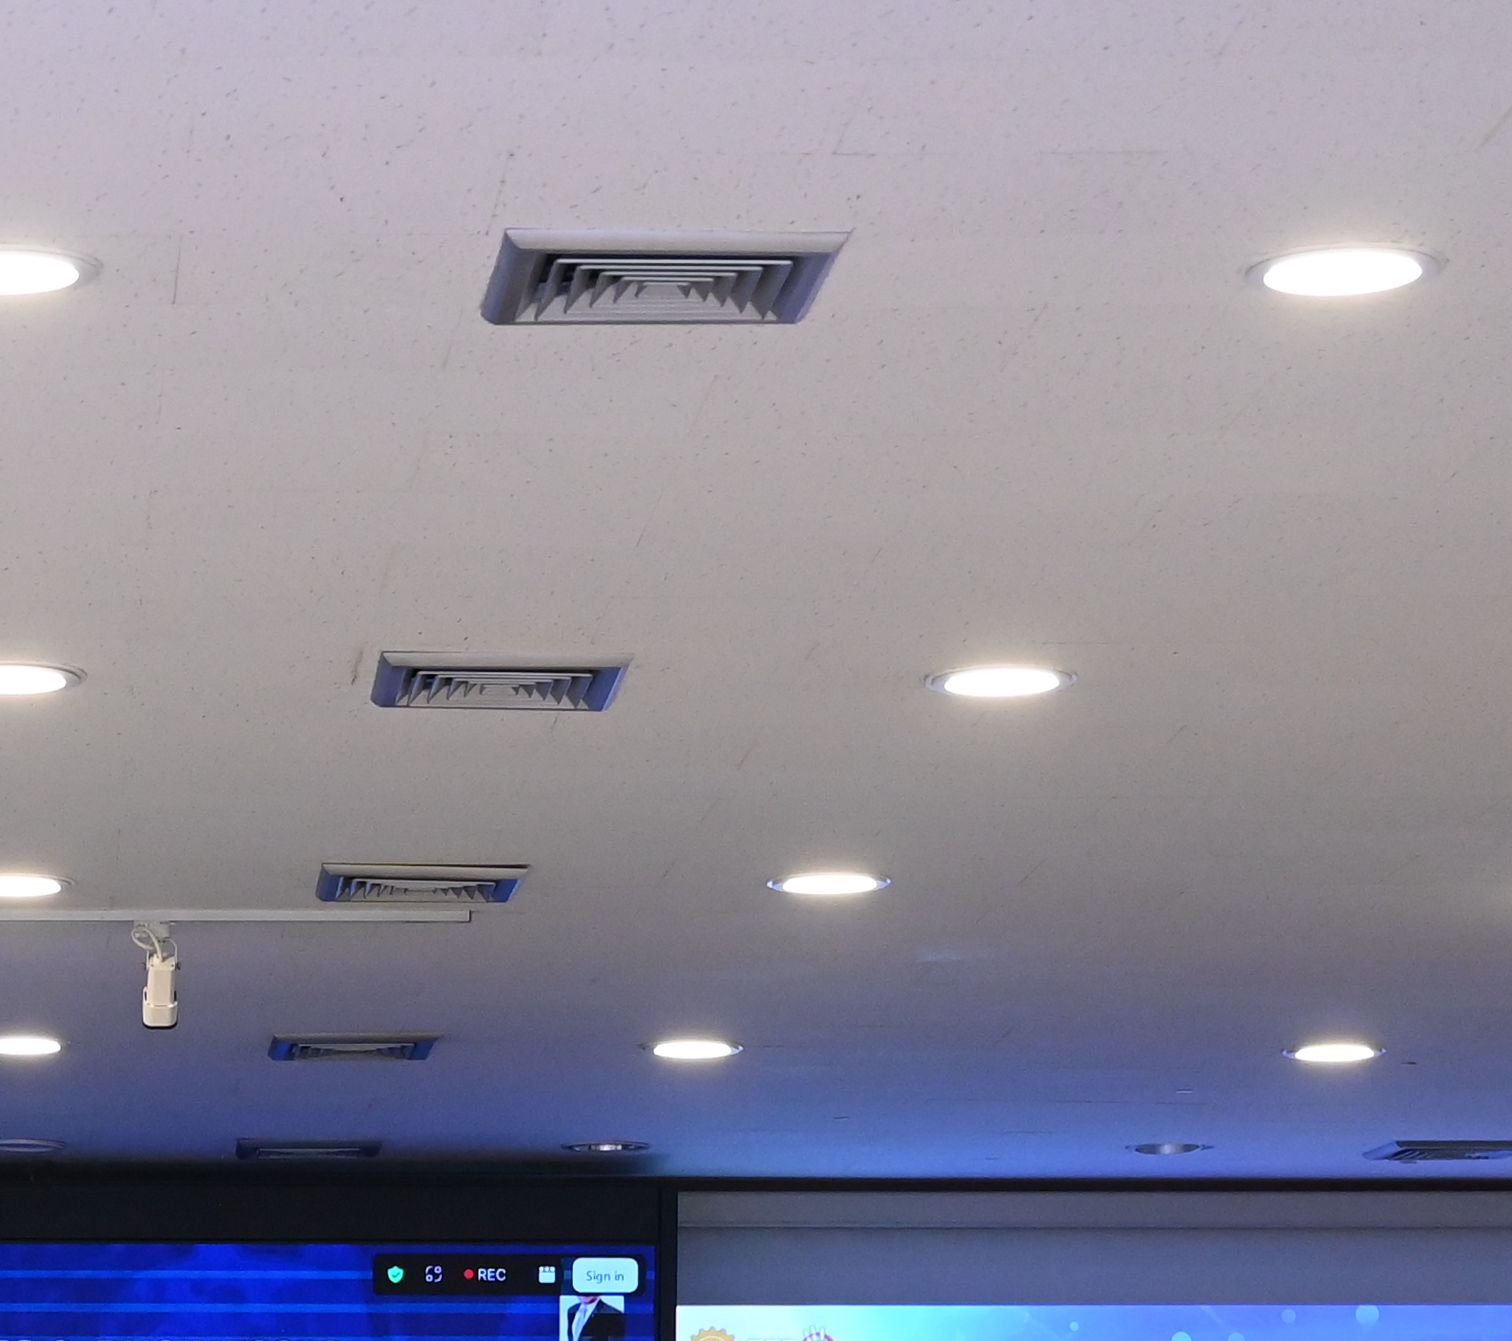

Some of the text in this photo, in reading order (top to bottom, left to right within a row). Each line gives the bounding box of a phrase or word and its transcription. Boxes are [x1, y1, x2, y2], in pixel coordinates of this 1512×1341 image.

[477, 1268, 506, 1282] REC
[586, 1270, 625, 1284] Sign in
